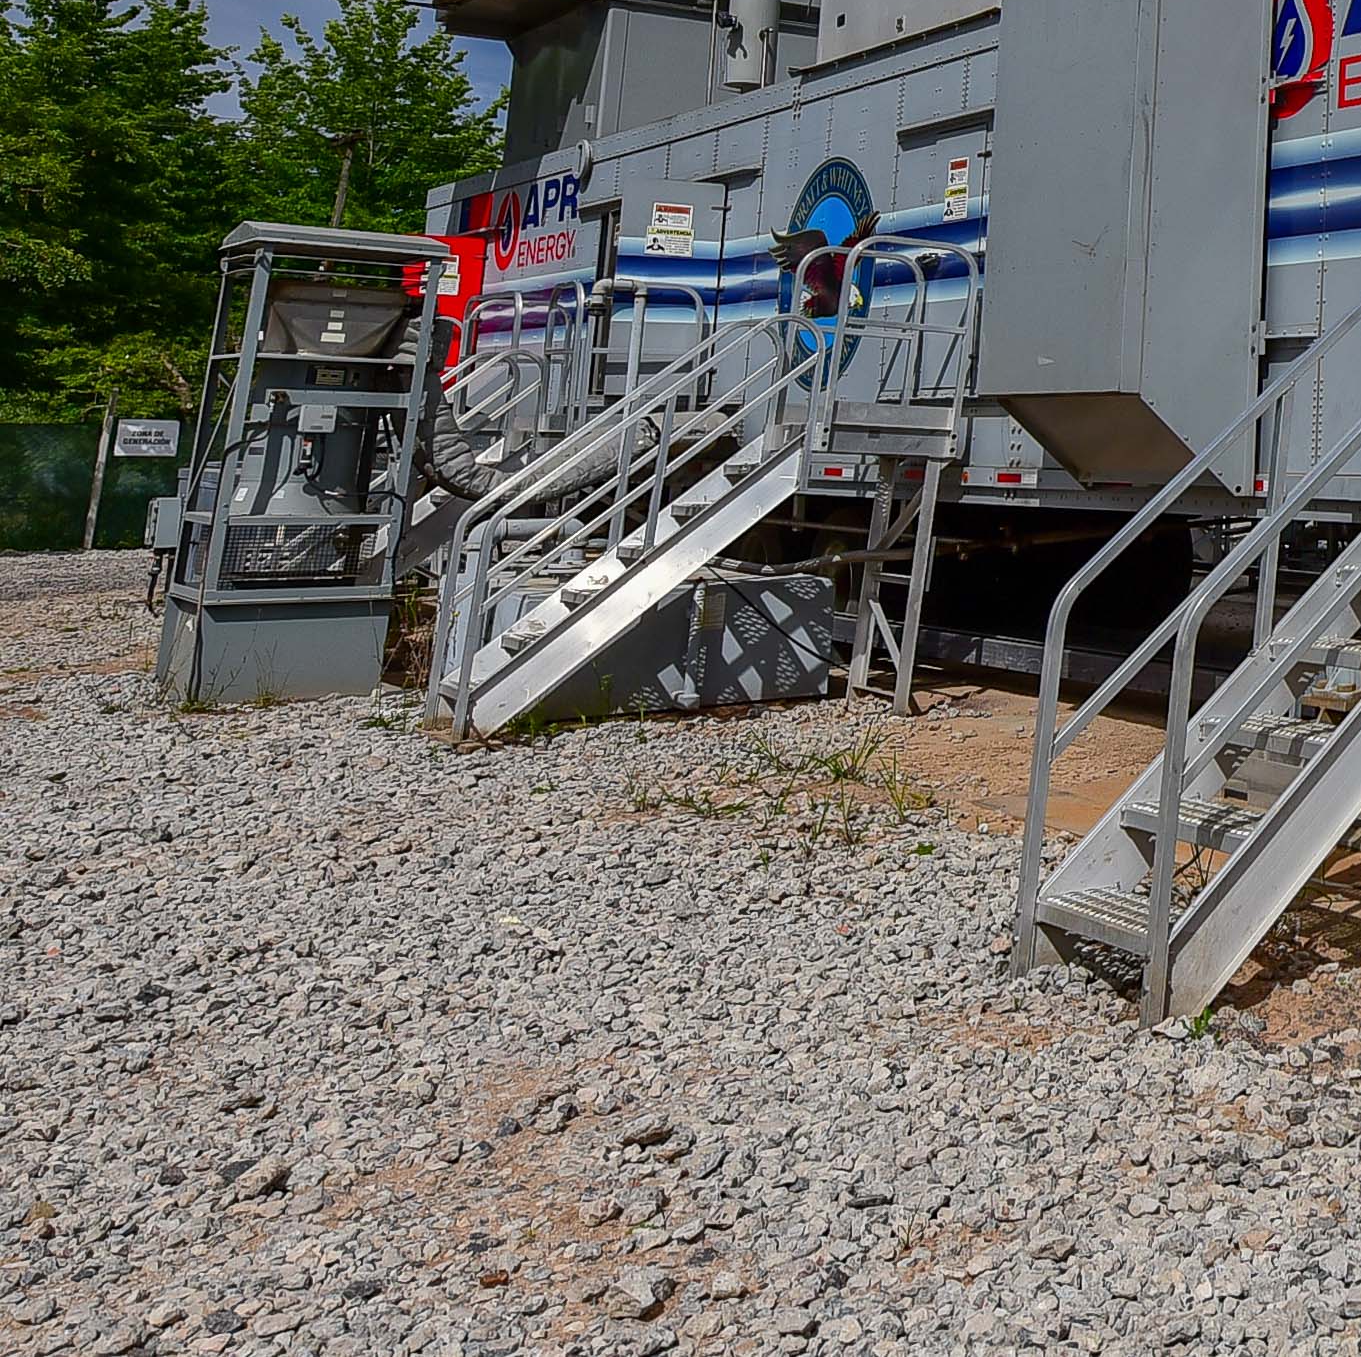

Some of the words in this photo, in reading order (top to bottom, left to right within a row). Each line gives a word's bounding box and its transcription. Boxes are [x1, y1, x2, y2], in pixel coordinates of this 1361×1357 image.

[521, 173, 580, 230] APR
[794, 175, 822, 230] PRATT
[821, 170, 830, 192] &
[829, 166, 869, 216] WHITNEY
